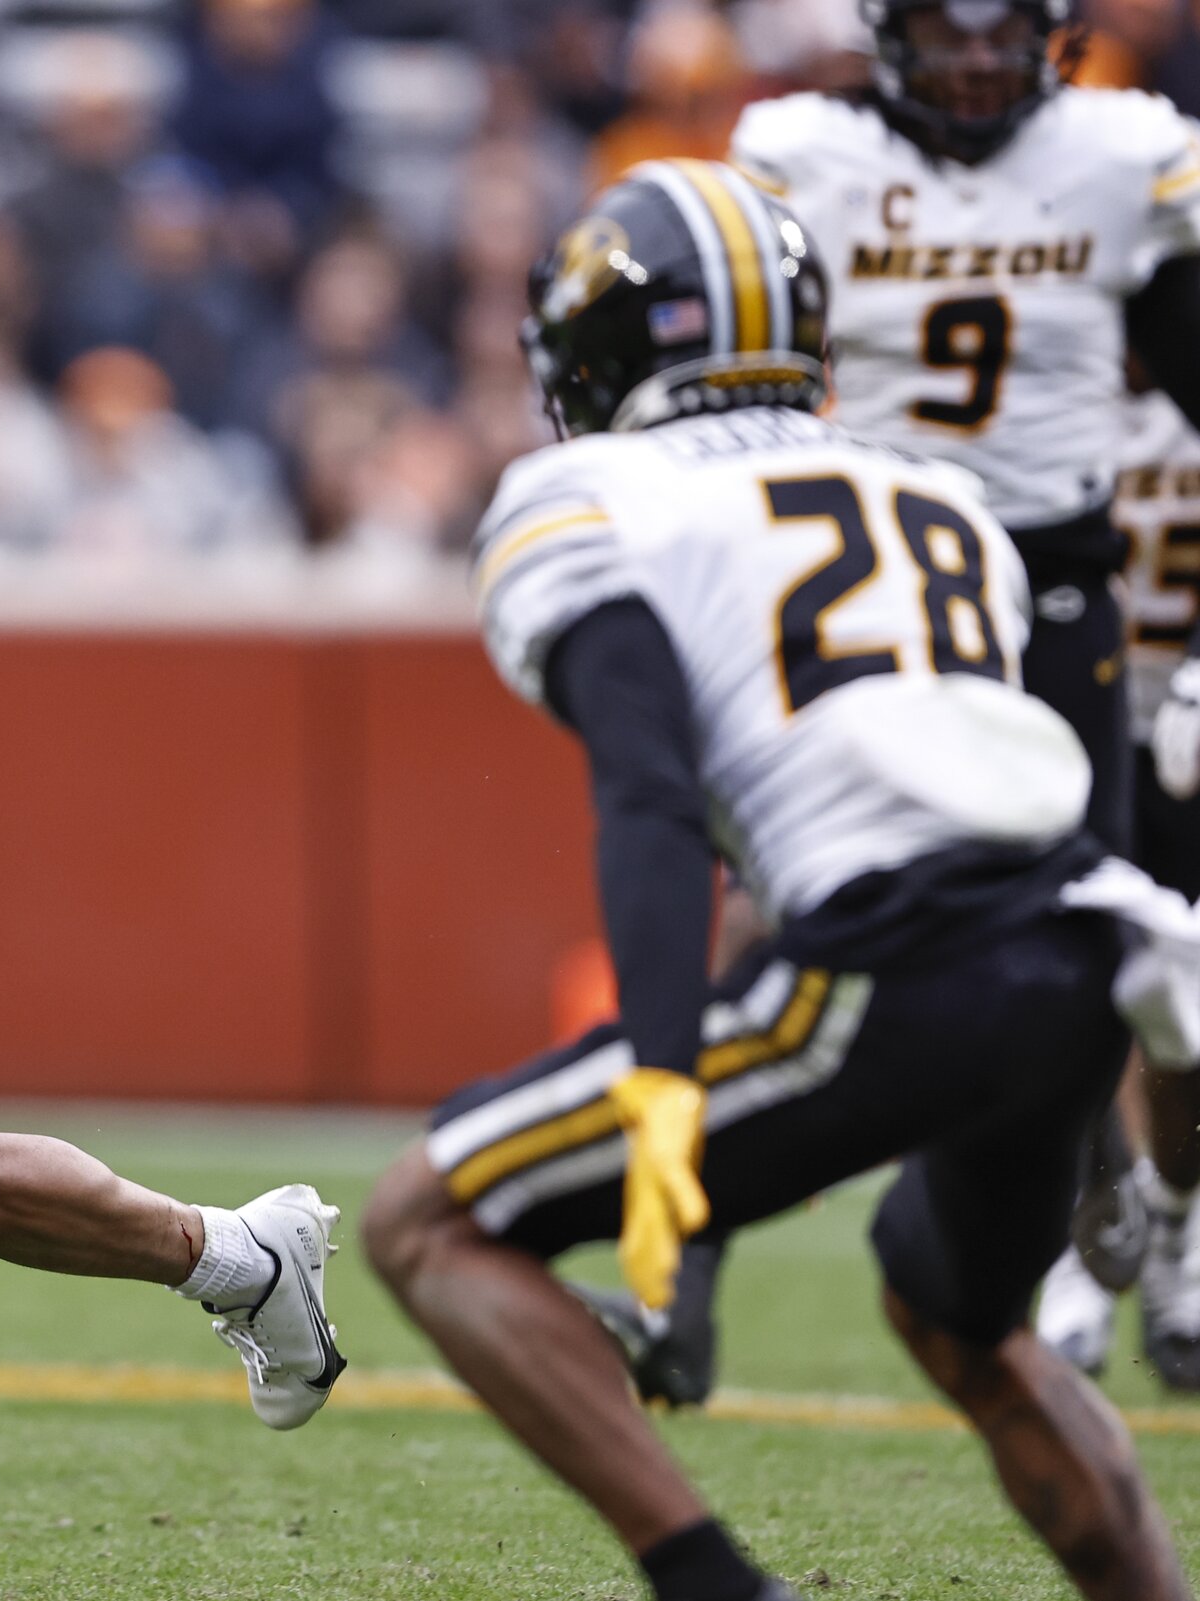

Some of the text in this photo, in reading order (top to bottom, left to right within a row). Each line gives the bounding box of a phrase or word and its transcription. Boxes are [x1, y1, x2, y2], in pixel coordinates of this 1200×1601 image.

[881, 183, 916, 230] C
[849, 234, 1094, 280] MIZZOU
[909, 293, 1011, 431] 9
[757, 472, 1010, 716] 28
